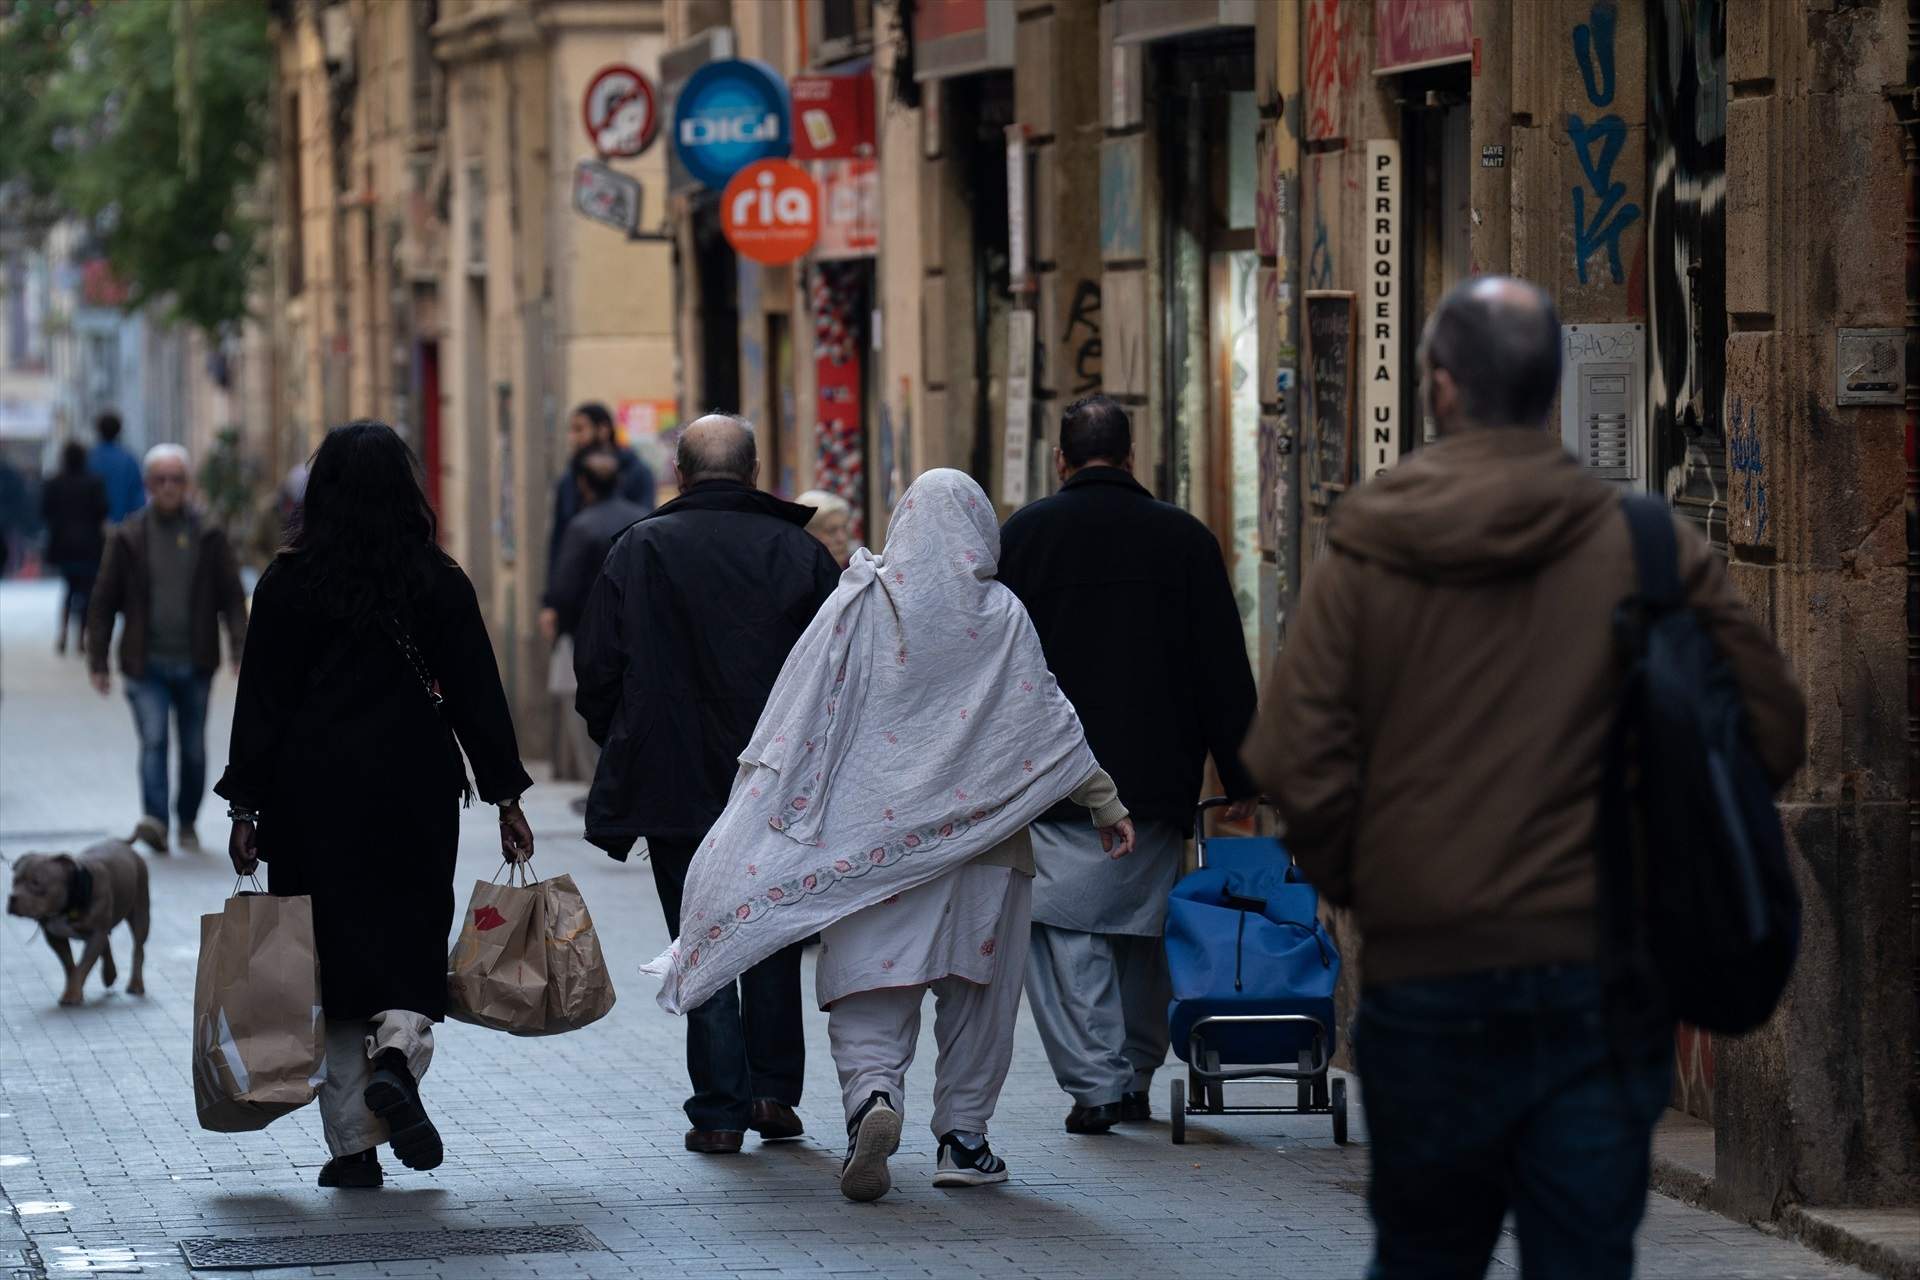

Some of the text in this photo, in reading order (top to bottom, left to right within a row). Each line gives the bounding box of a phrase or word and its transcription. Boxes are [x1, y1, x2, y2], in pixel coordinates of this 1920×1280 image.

[681, 113, 779, 146] DIGI
[732, 170, 812, 226] ria
[1374, 155, 1391, 381] PERRUQUERIA
